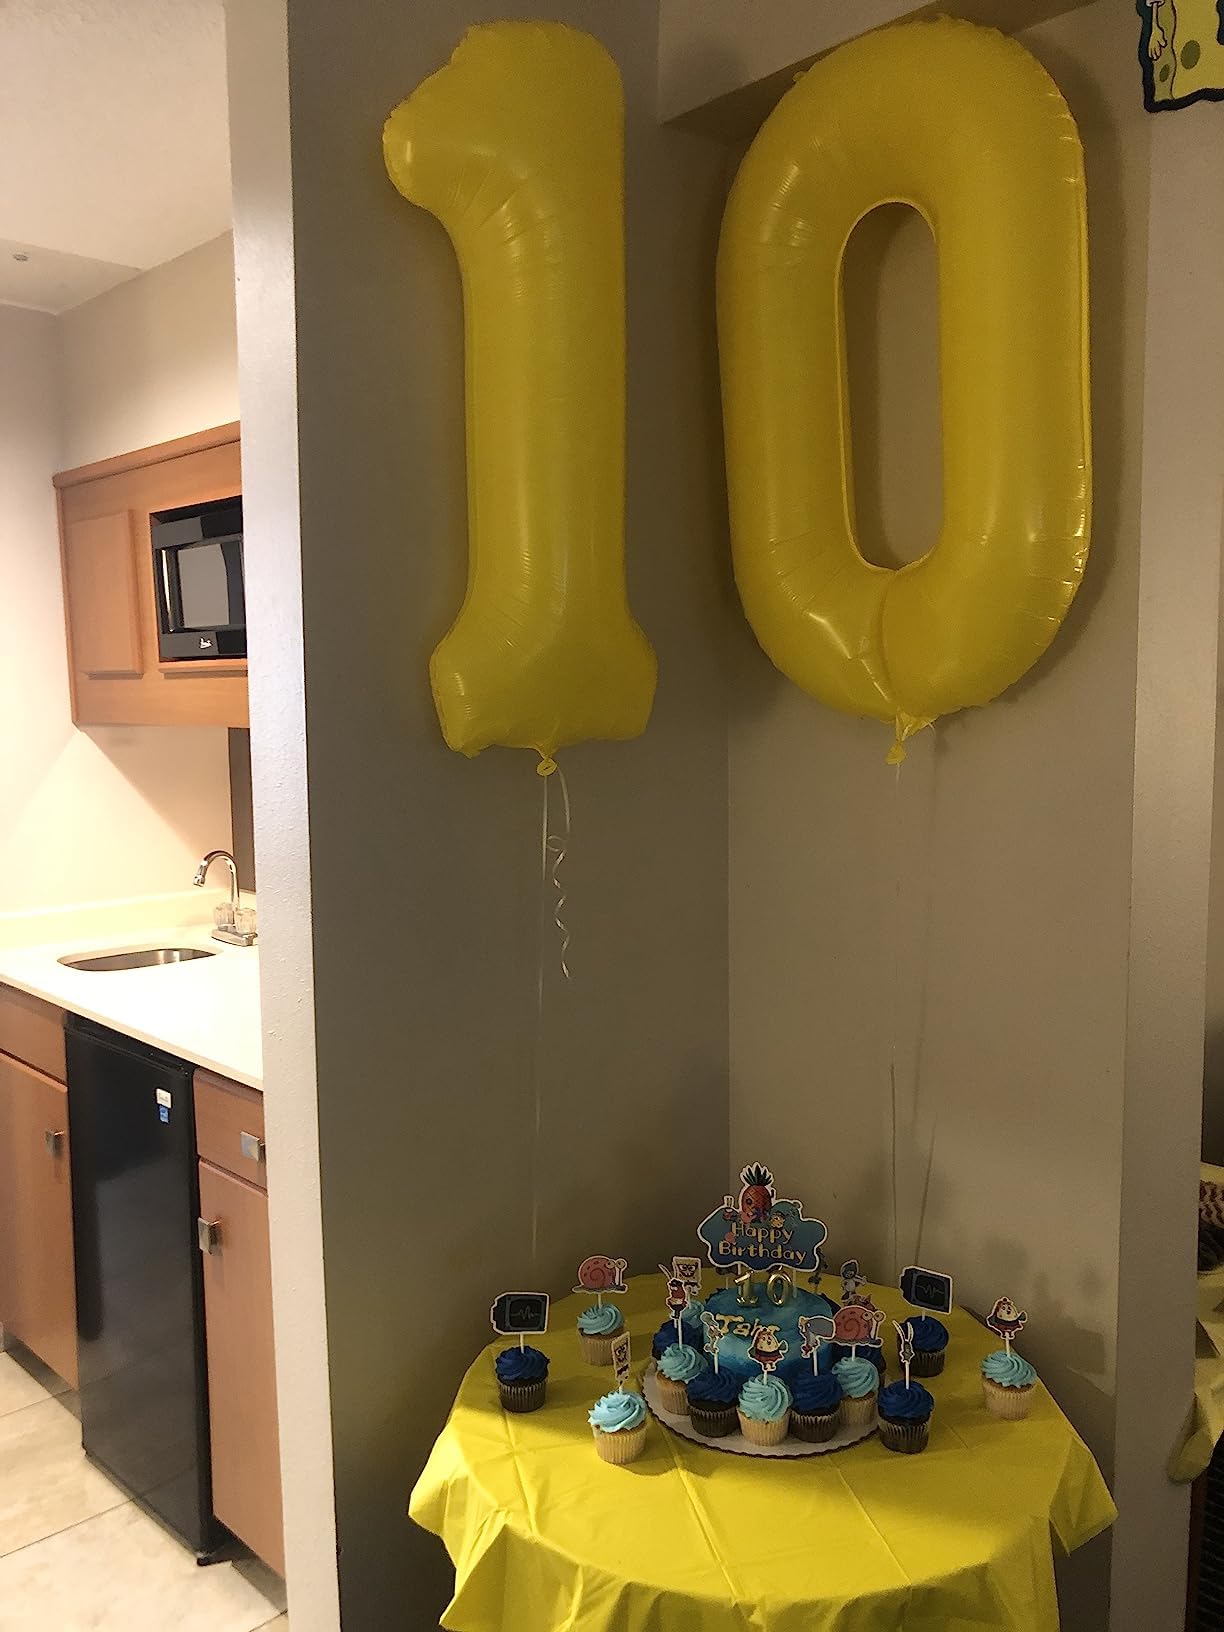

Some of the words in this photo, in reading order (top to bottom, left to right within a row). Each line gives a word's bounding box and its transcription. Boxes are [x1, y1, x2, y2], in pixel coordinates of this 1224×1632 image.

[731, 1222, 793, 1244] Happy
[718, 1240, 807, 1266] Birthday
[734, 1270, 794, 1307] 10
